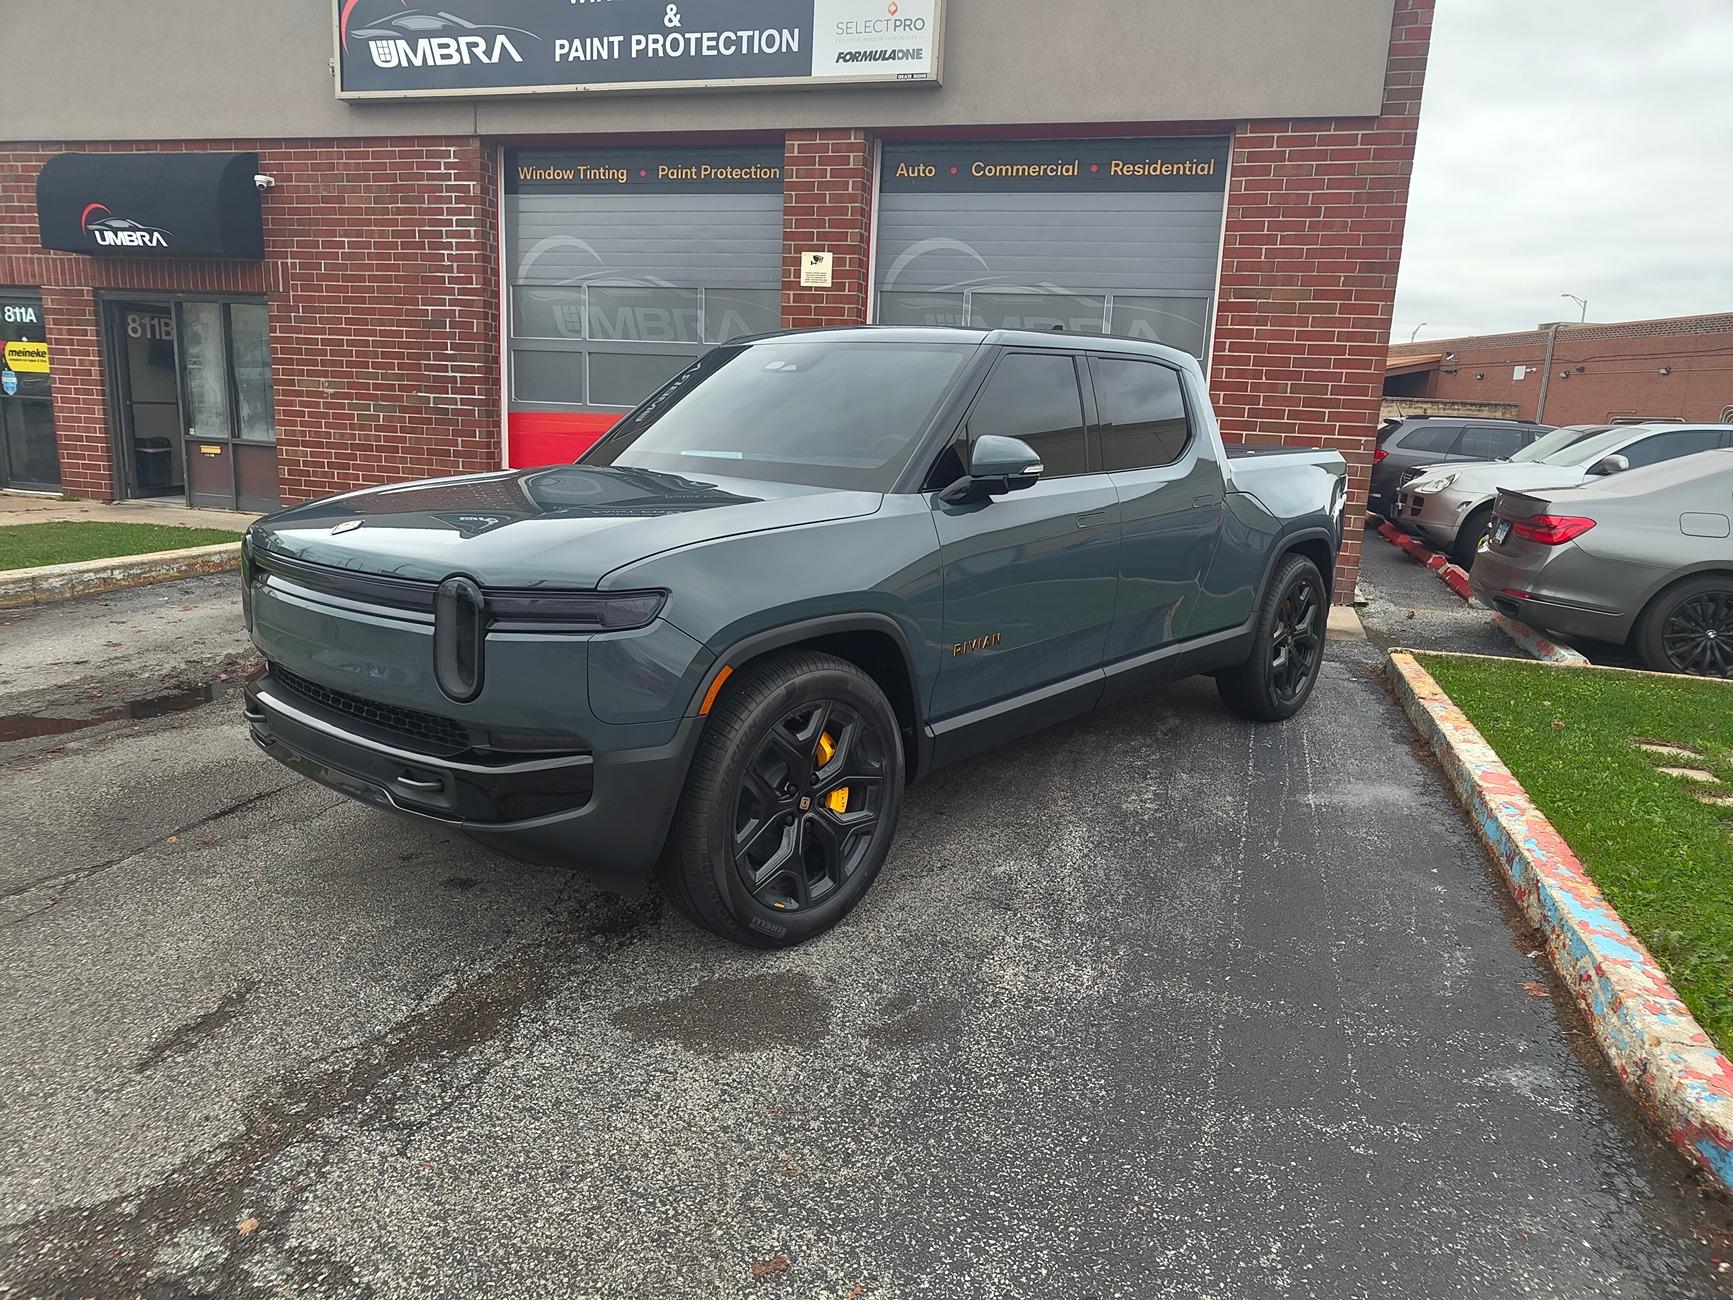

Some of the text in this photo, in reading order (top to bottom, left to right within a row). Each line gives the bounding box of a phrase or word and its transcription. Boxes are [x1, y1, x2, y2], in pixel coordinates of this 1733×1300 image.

[663, 4, 682, 28] &
[368, 34, 524, 68] UMBRA
[554, 28, 800, 62] PAINT PROTECTION
[835, 48, 923, 63] FORMULAONE
[518, 164, 780, 183] Window Tinting Paint Protection
[895, 158, 1215, 177] Auto Commercial Residential
[94, 230, 168, 248] UMBRA
[4, 306, 37, 323] 811A
[128, 314, 174, 340] 811B
[8, 347, 47, 358] meineke
